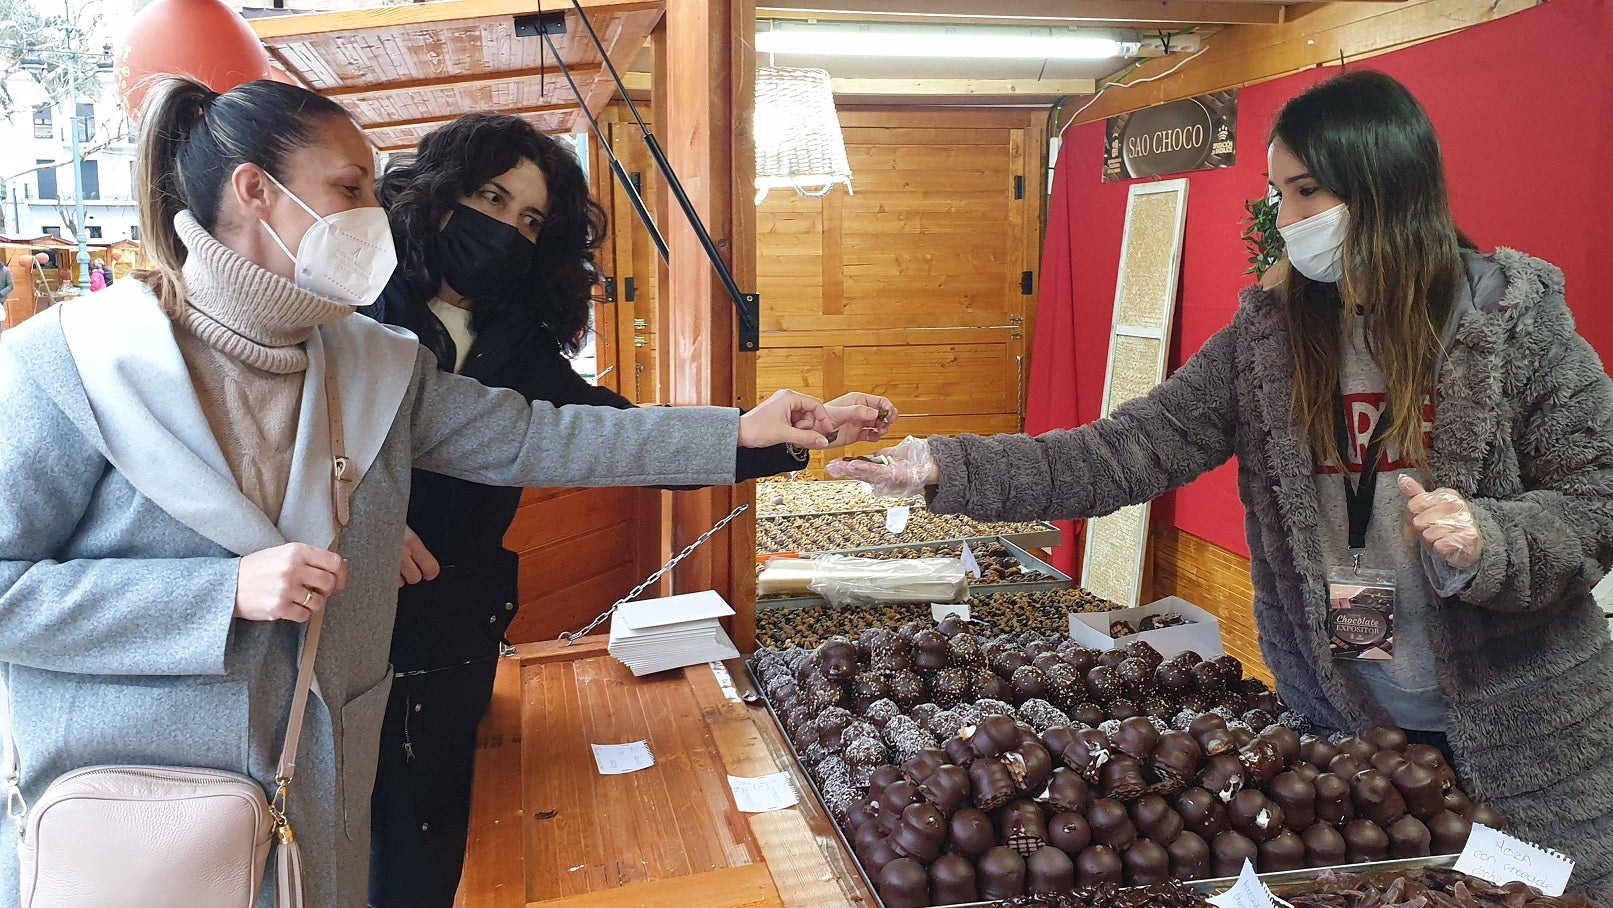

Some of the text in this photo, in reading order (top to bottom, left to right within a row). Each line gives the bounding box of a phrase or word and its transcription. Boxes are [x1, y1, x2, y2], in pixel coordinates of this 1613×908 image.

[1129, 135, 1150, 158] SAO
[1153, 125, 1204, 154] CHOCO
[1336, 614, 1379, 626] Chocolate
[1336, 625, 1380, 635] EXPOSITOR
